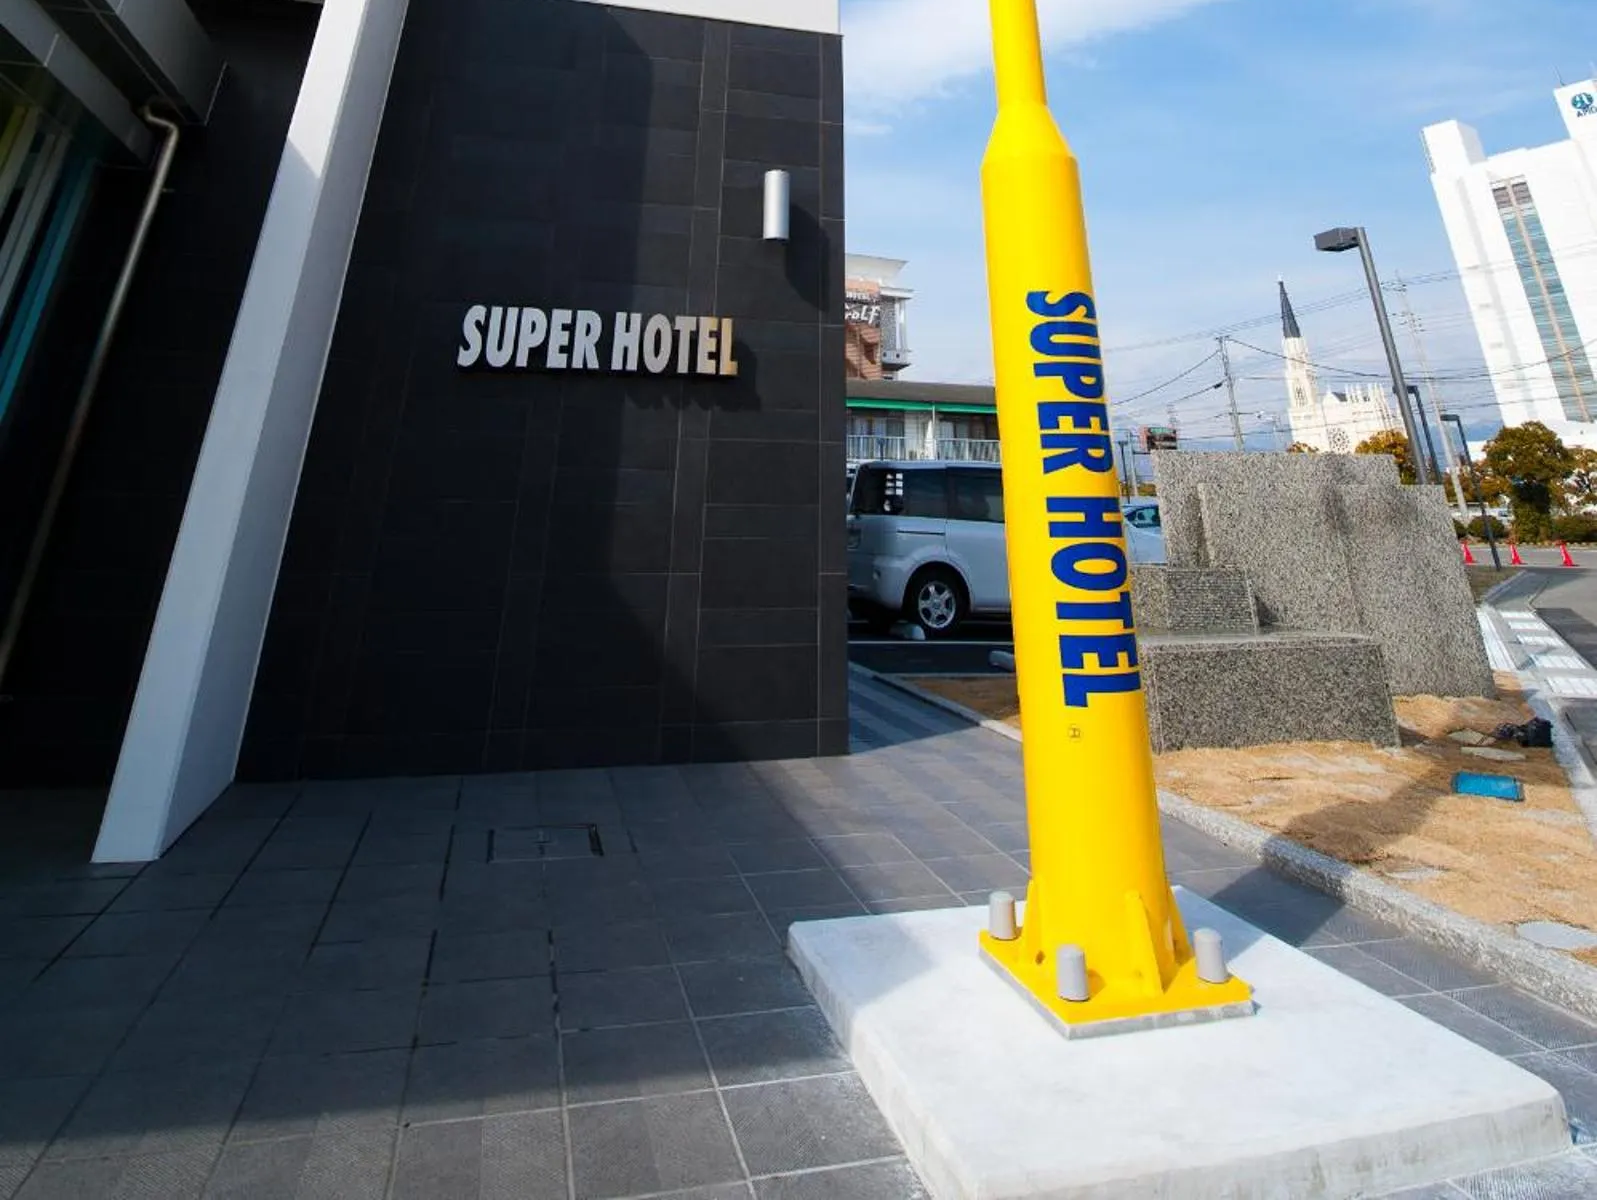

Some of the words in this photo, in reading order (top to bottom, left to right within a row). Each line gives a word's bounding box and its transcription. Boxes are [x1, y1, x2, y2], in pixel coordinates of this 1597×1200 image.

[457, 304, 602, 369] SUPER
[611, 311, 739, 376] HOTEL
[1026, 290, 1112, 475] SUPER
[1046, 496, 1141, 708] HOTEL
